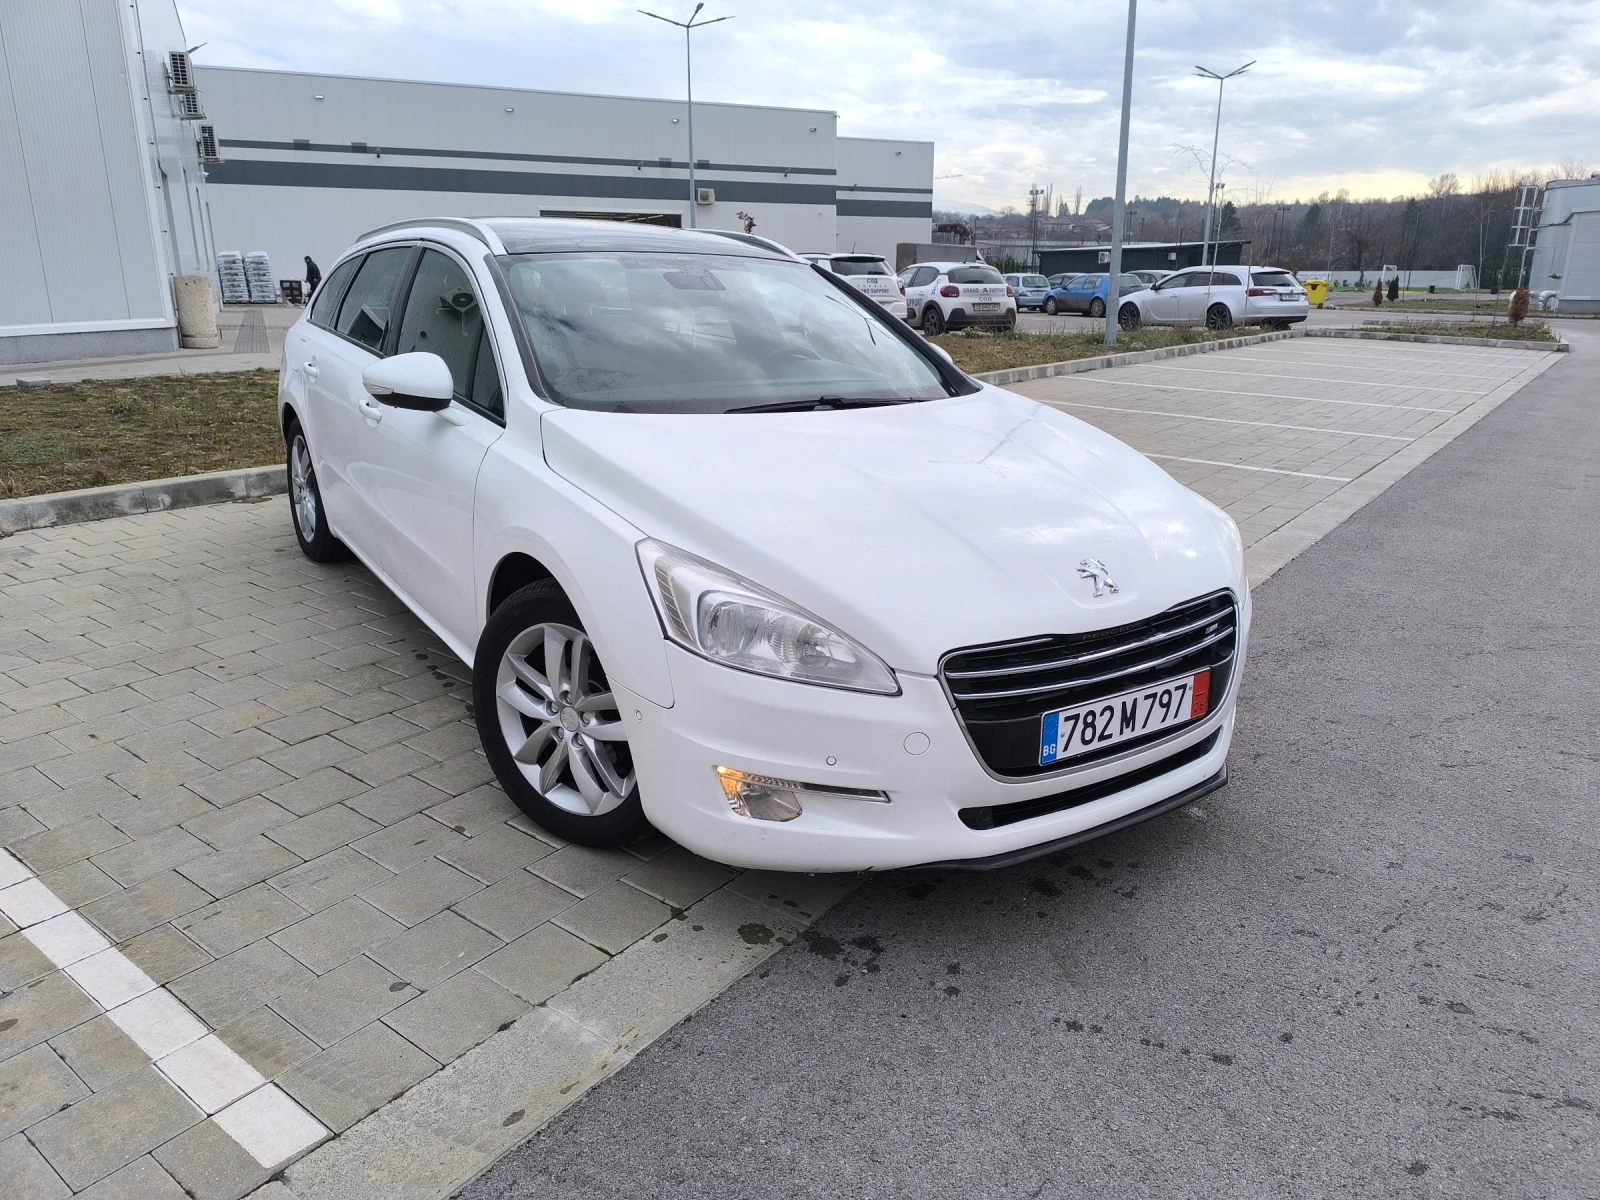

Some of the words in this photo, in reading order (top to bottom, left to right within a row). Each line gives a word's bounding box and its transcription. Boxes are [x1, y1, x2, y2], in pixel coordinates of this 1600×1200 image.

[906, 298, 923, 307] UPPORT
[1082, 622, 1142, 640] PEUGEOT
[1042, 743, 1057, 757] BG
